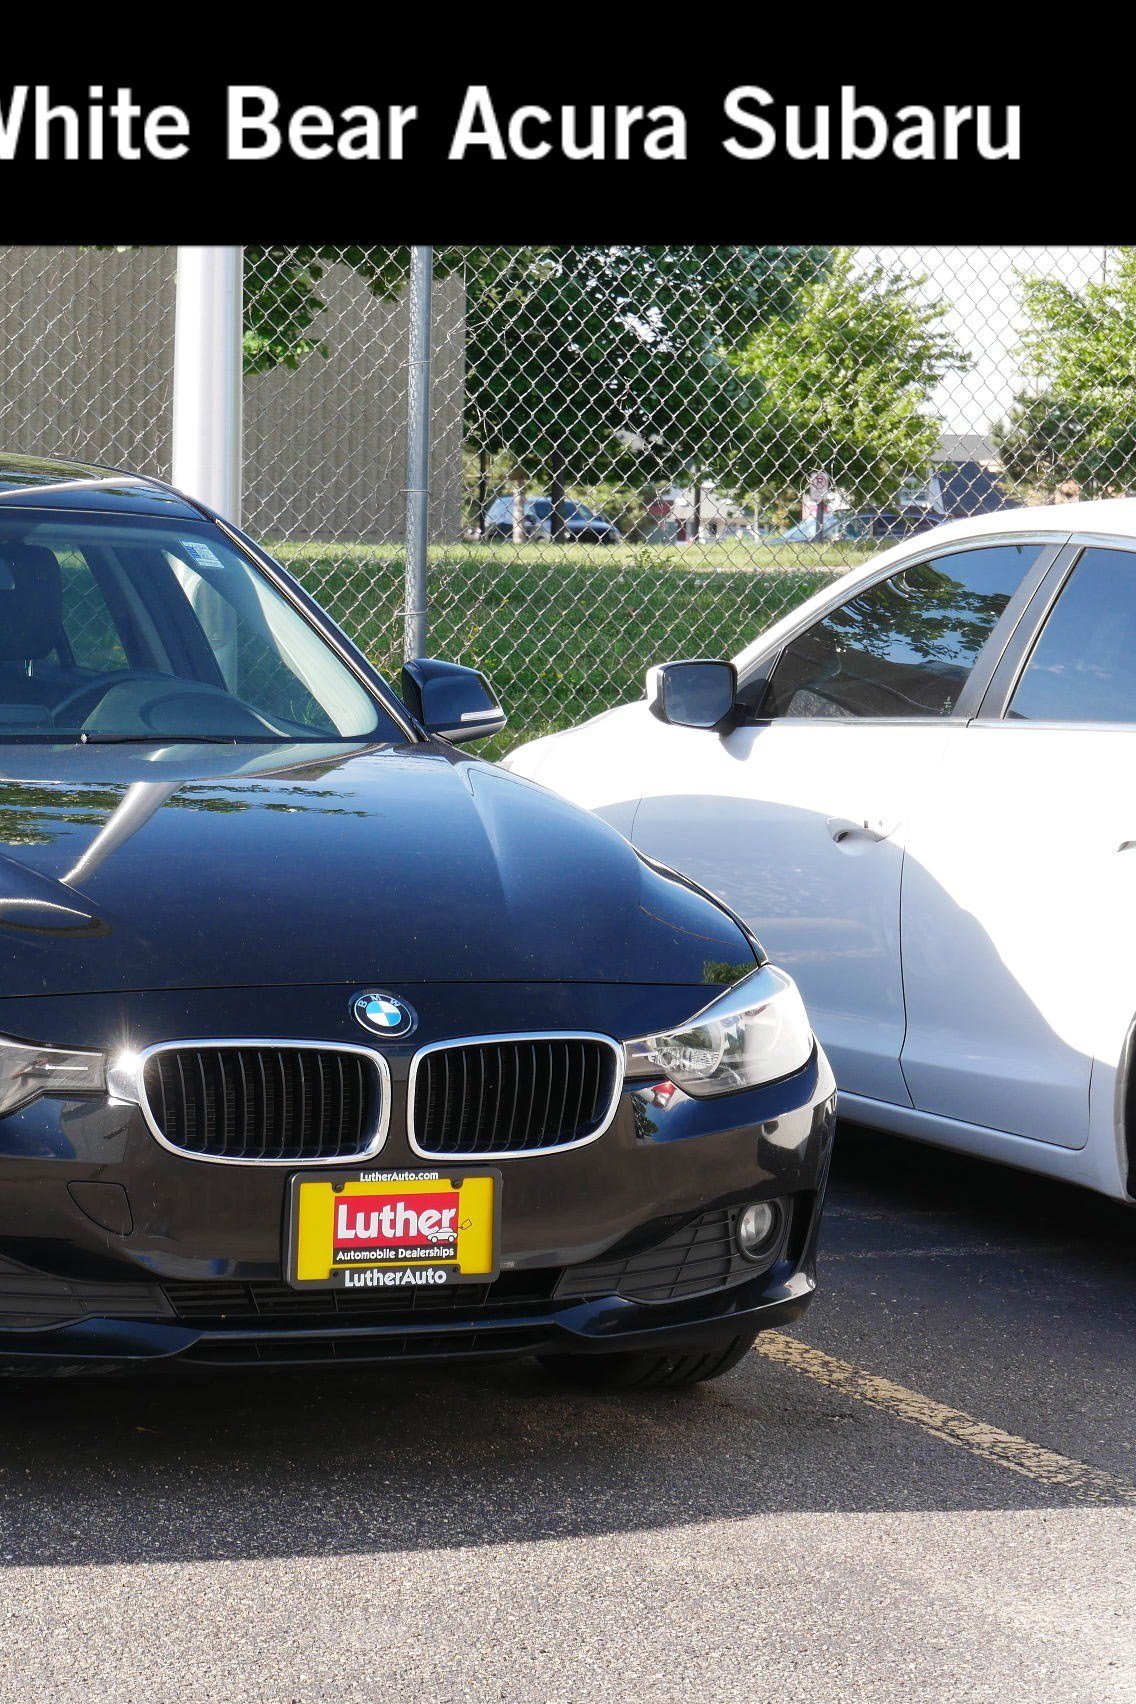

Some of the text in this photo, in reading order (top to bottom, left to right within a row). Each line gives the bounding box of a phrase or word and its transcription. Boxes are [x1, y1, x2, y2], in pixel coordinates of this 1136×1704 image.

[357, 994, 401, 1009] BMW
[360, 1170, 439, 1183] LutherAuto.com
[337, 1201, 457, 1240] Luther
[336, 1246, 455, 1261] Automobile Dealerships
[344, 1268, 447, 1288] LutherAuto
